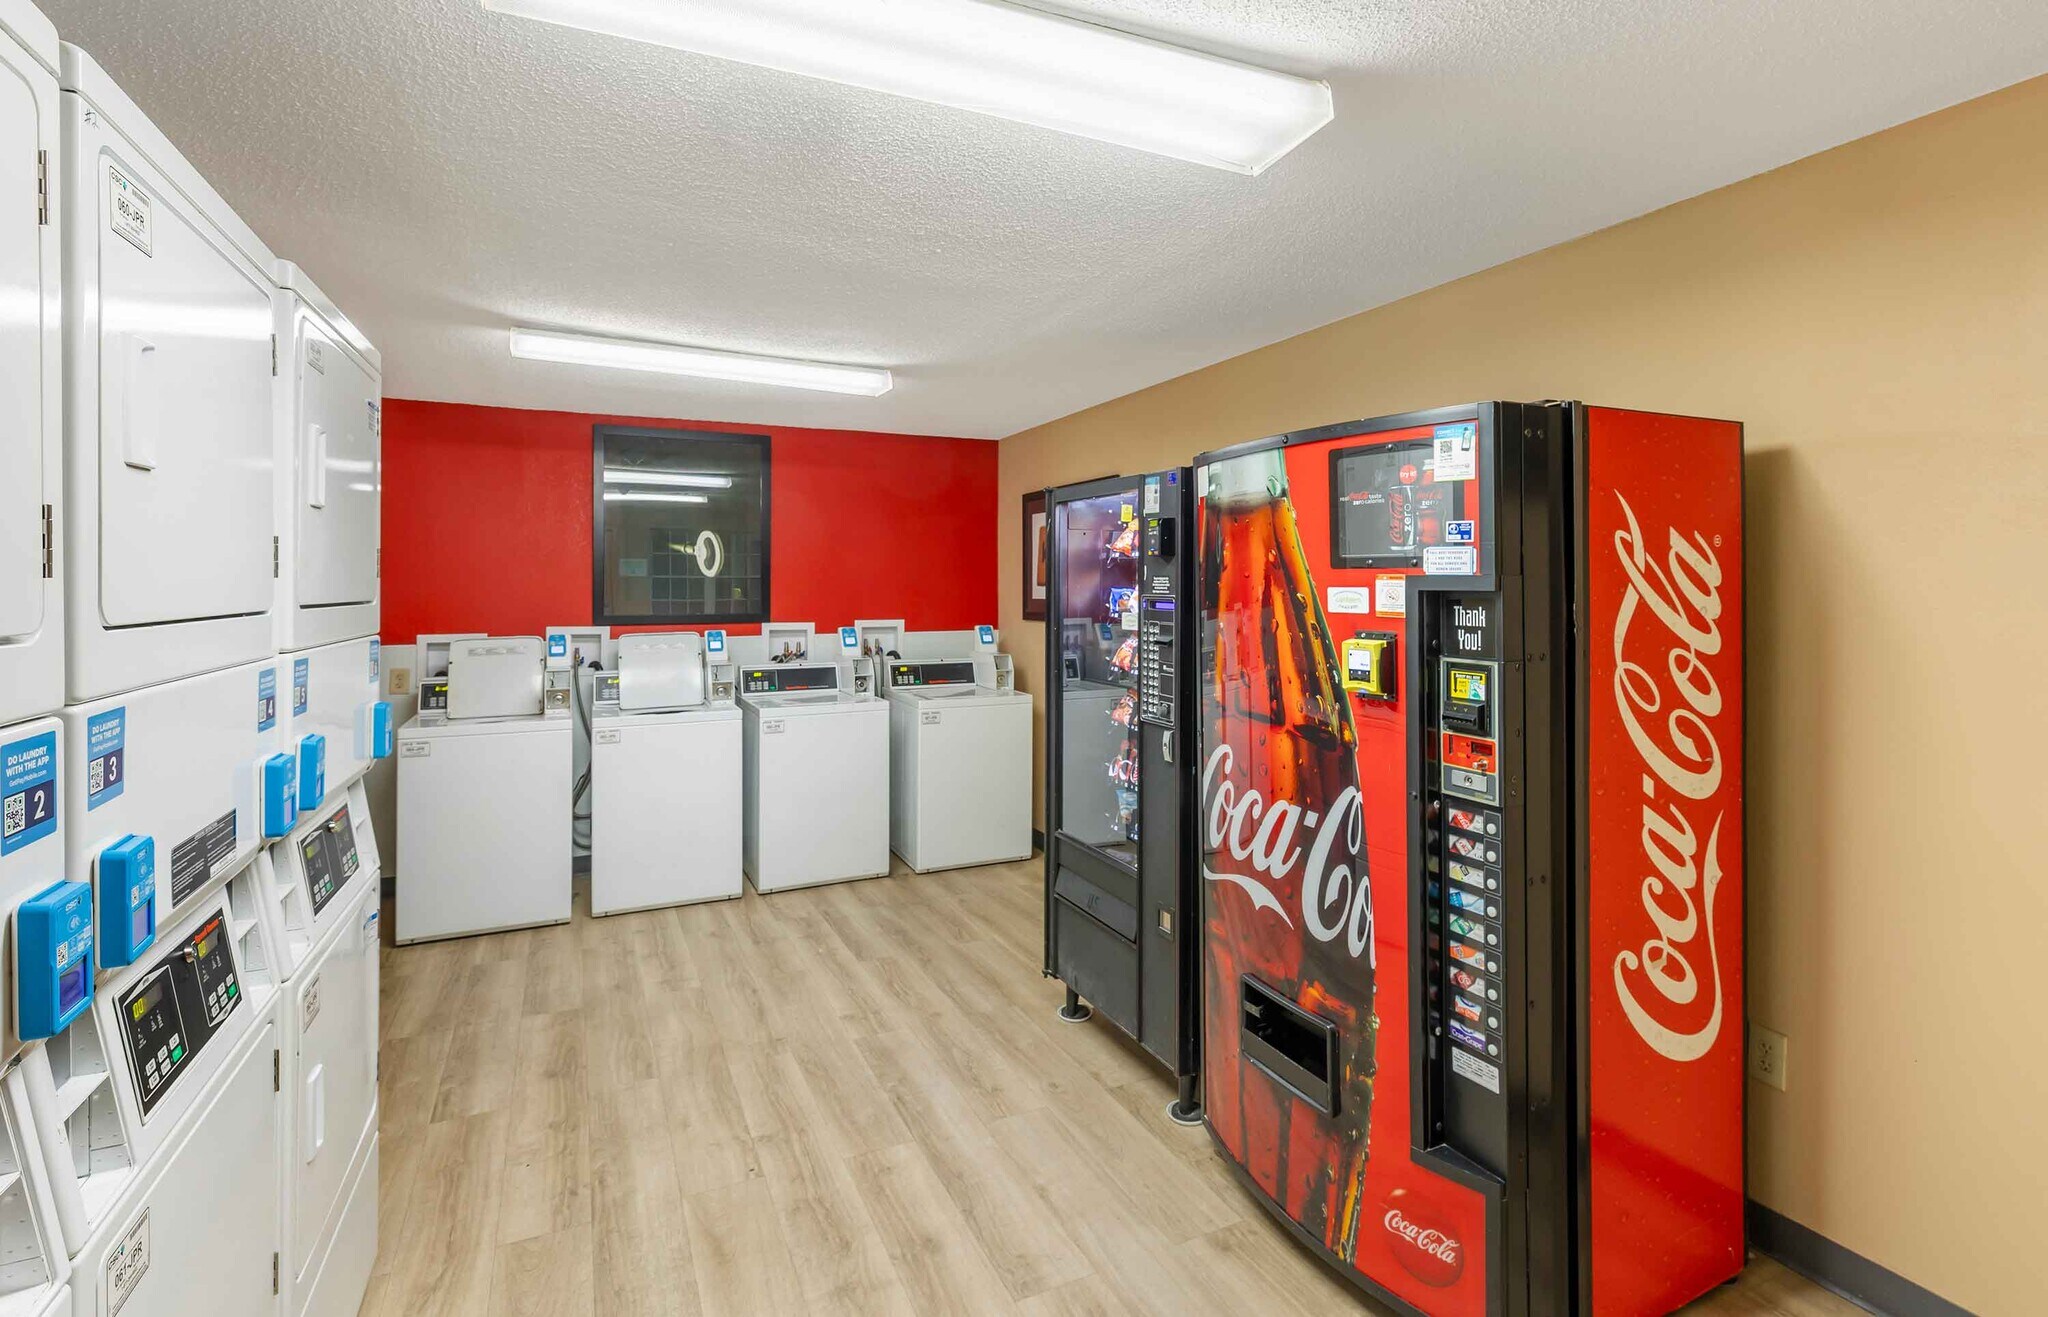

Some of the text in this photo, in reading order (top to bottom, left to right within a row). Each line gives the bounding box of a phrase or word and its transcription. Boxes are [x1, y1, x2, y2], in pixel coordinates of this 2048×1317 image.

[117, 197, 145, 229] 060-JPR
[1404, 503, 1412, 532] zero
[1453, 605, 1486, 627] Thank
[1458, 629, 1482, 651] You!
[268, 699, 273, 716] 4
[6, 755, 50, 778] WITH THE APP
[7, 745, 48, 766] DO LAUNDRY
[109, 756, 117, 781] 3
[1614, 488, 1723, 1063] Coca-Cola
[34, 789, 46, 820] 2
[1384, 1209, 1460, 1264] Coca-Cola
[115, 1241, 143, 1288] 061-JPR
